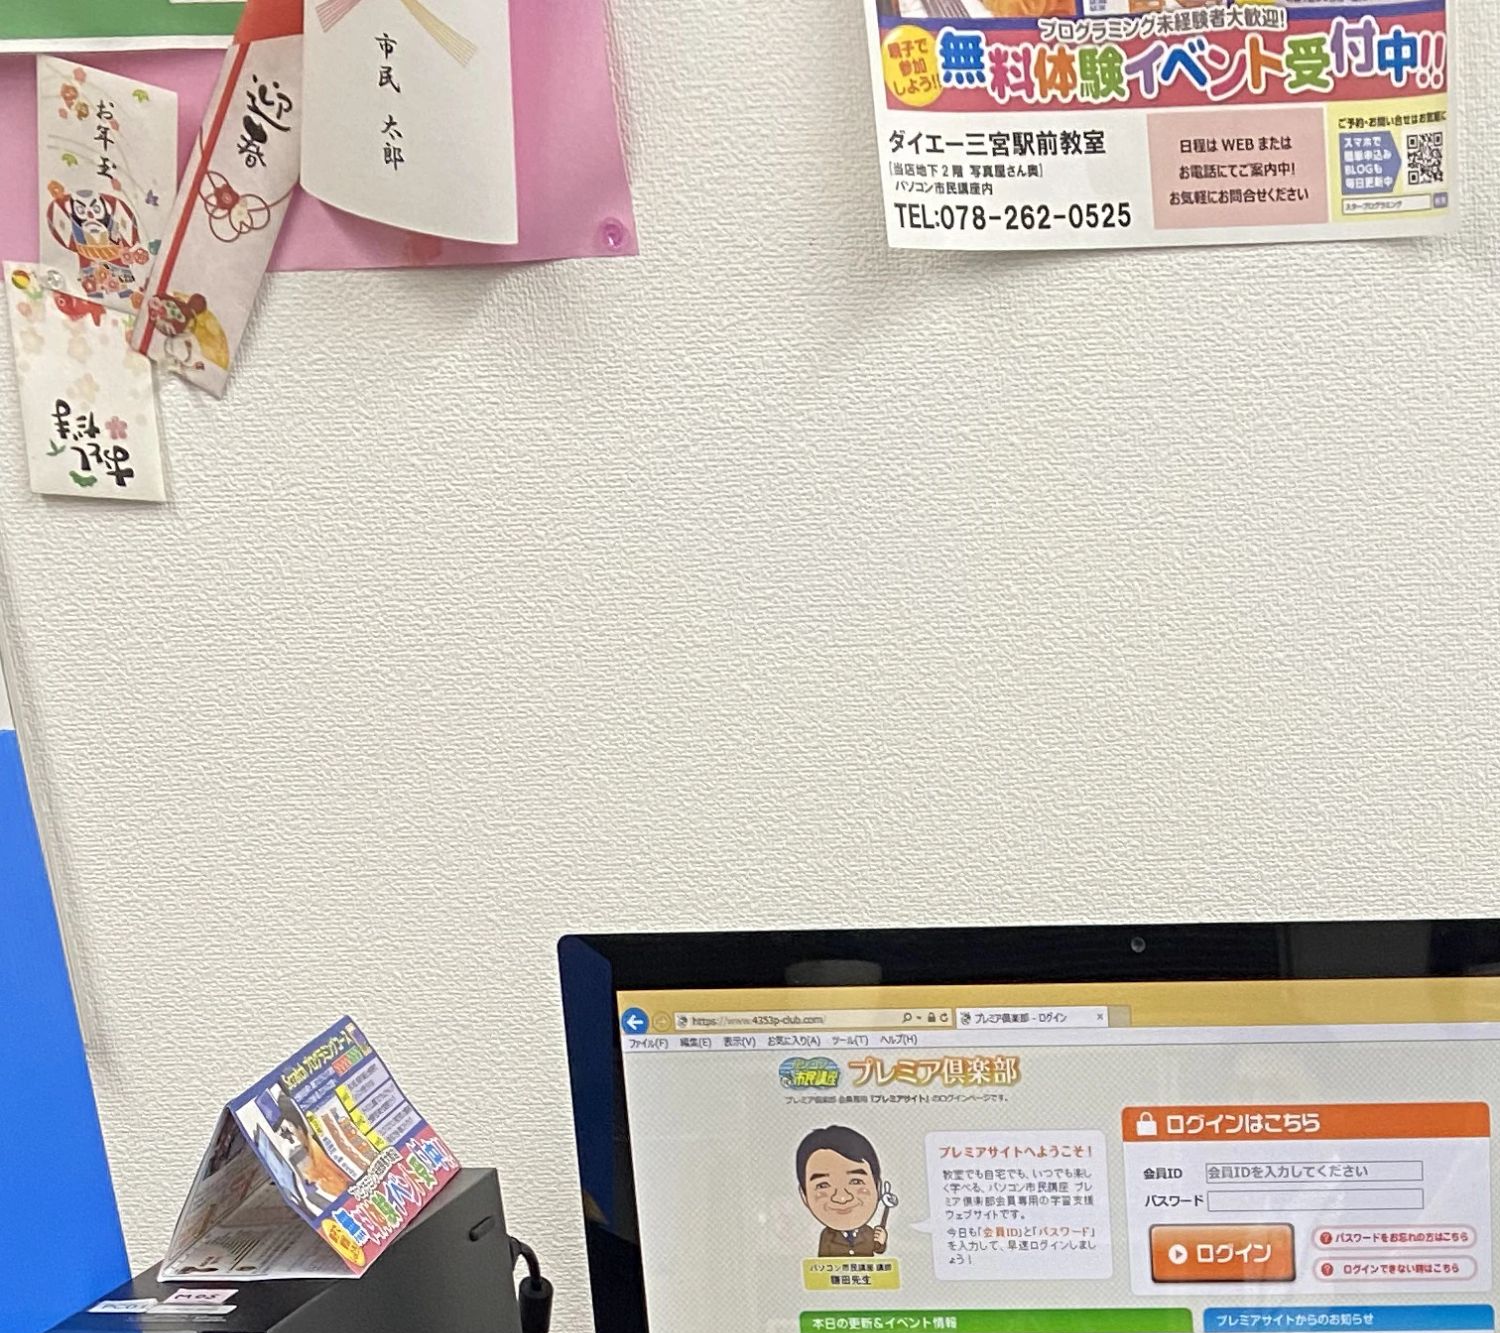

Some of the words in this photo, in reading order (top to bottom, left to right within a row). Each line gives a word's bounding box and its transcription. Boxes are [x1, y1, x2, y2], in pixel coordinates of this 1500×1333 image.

[898, 58, 928, 77] 参加
[938, 18, 1445, 99] 無料体験イベント受付中!!
[888, 129, 1107, 158] ダイエー三宮駅前教室
[1180, 138, 1217, 153] 日程は
[1221, 137, 1255, 151] WEB
[1258, 135, 1293, 151] または
[895, 180, 994, 196] パソコン市民講座内
[1168, 187, 1310, 206] お気軽にお問合せください
[893, 201, 1132, 231] TEL:078-262-0525
[849, 1054, 1020, 1087] プレミア倶楽部
[1166, 1112, 1321, 1134] ログインはこちら
[1143, 1167, 1183, 1181] 会員ID
[1207, 1164, 1369, 1179] 会員IDを入力してください
[1144, 1194, 1205, 1208] パスワード
[1196, 1242, 1272, 1264] ログイン
[812, 1316, 958, 1331] 本日の更新&イベント情報
[1216, 1313, 1375, 1327] プレミアサイトからのお知らせ
